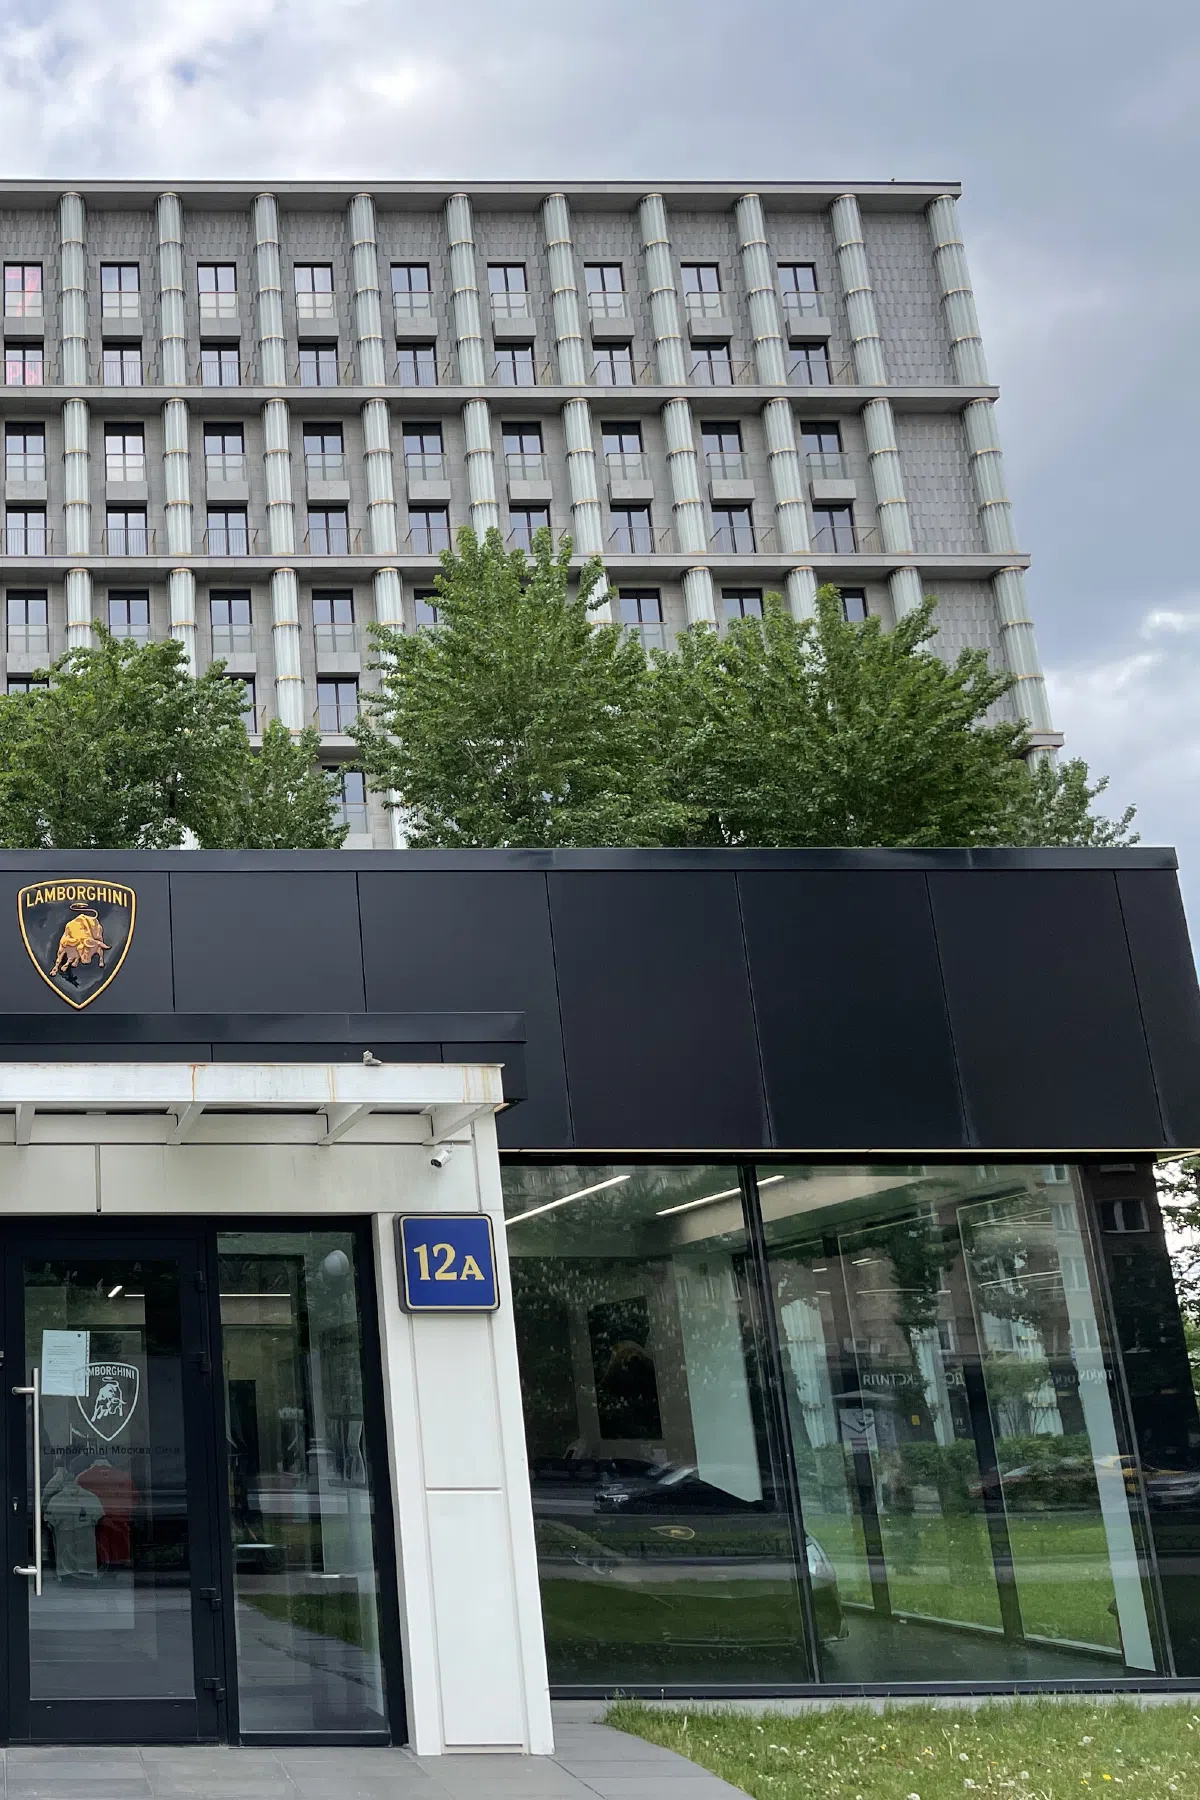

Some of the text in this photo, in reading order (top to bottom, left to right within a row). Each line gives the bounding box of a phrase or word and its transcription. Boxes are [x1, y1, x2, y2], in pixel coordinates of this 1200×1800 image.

[26, 885, 128, 908] LAMBORGHINI
[85, 1365, 135, 1380] MBORGHINI
[43, 1446, 108, 1456] Lamborghini
[111, 1446, 151, 1455] Москва
